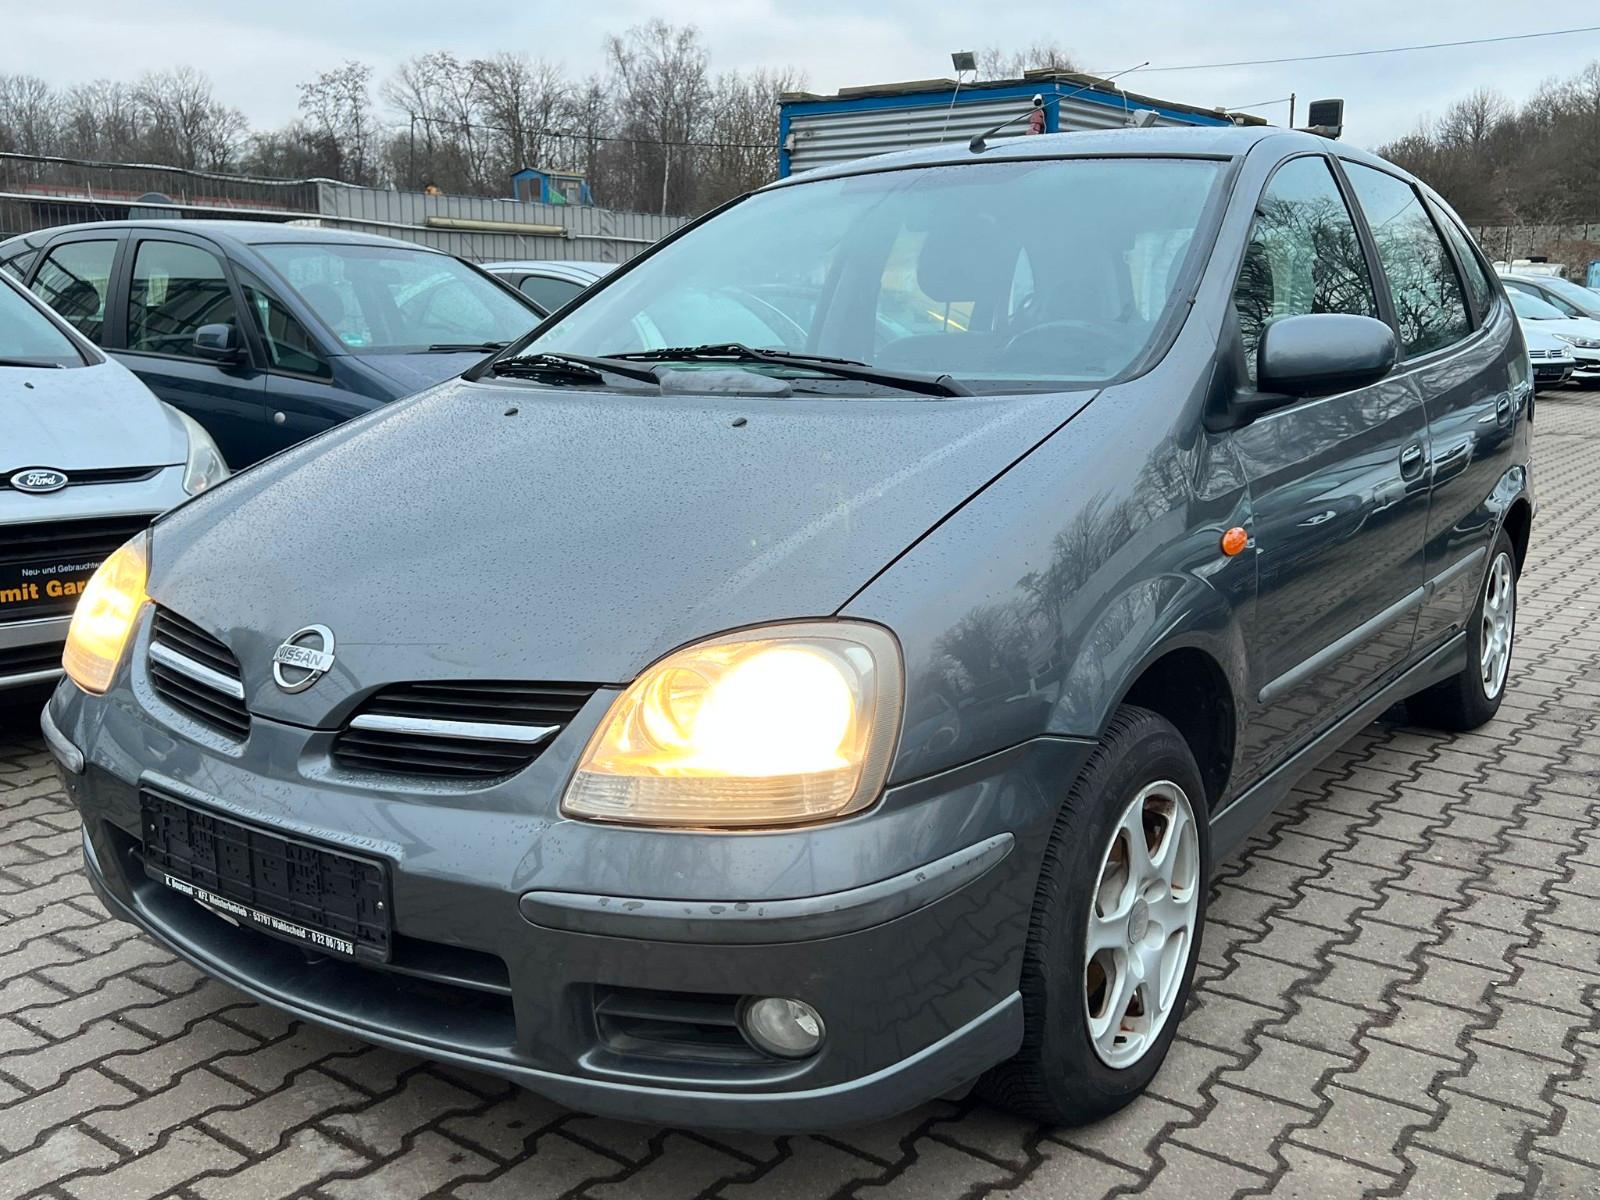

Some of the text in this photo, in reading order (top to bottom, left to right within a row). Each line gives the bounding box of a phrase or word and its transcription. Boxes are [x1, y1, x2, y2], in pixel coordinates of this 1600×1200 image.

[26, 472, 56, 486] Ford
[21, 568, 41, 577] Neu-
[42, 565, 56, 575] und
[0, 580, 87, 603] mit Gar
[276, 645, 325, 666] NISSAN
